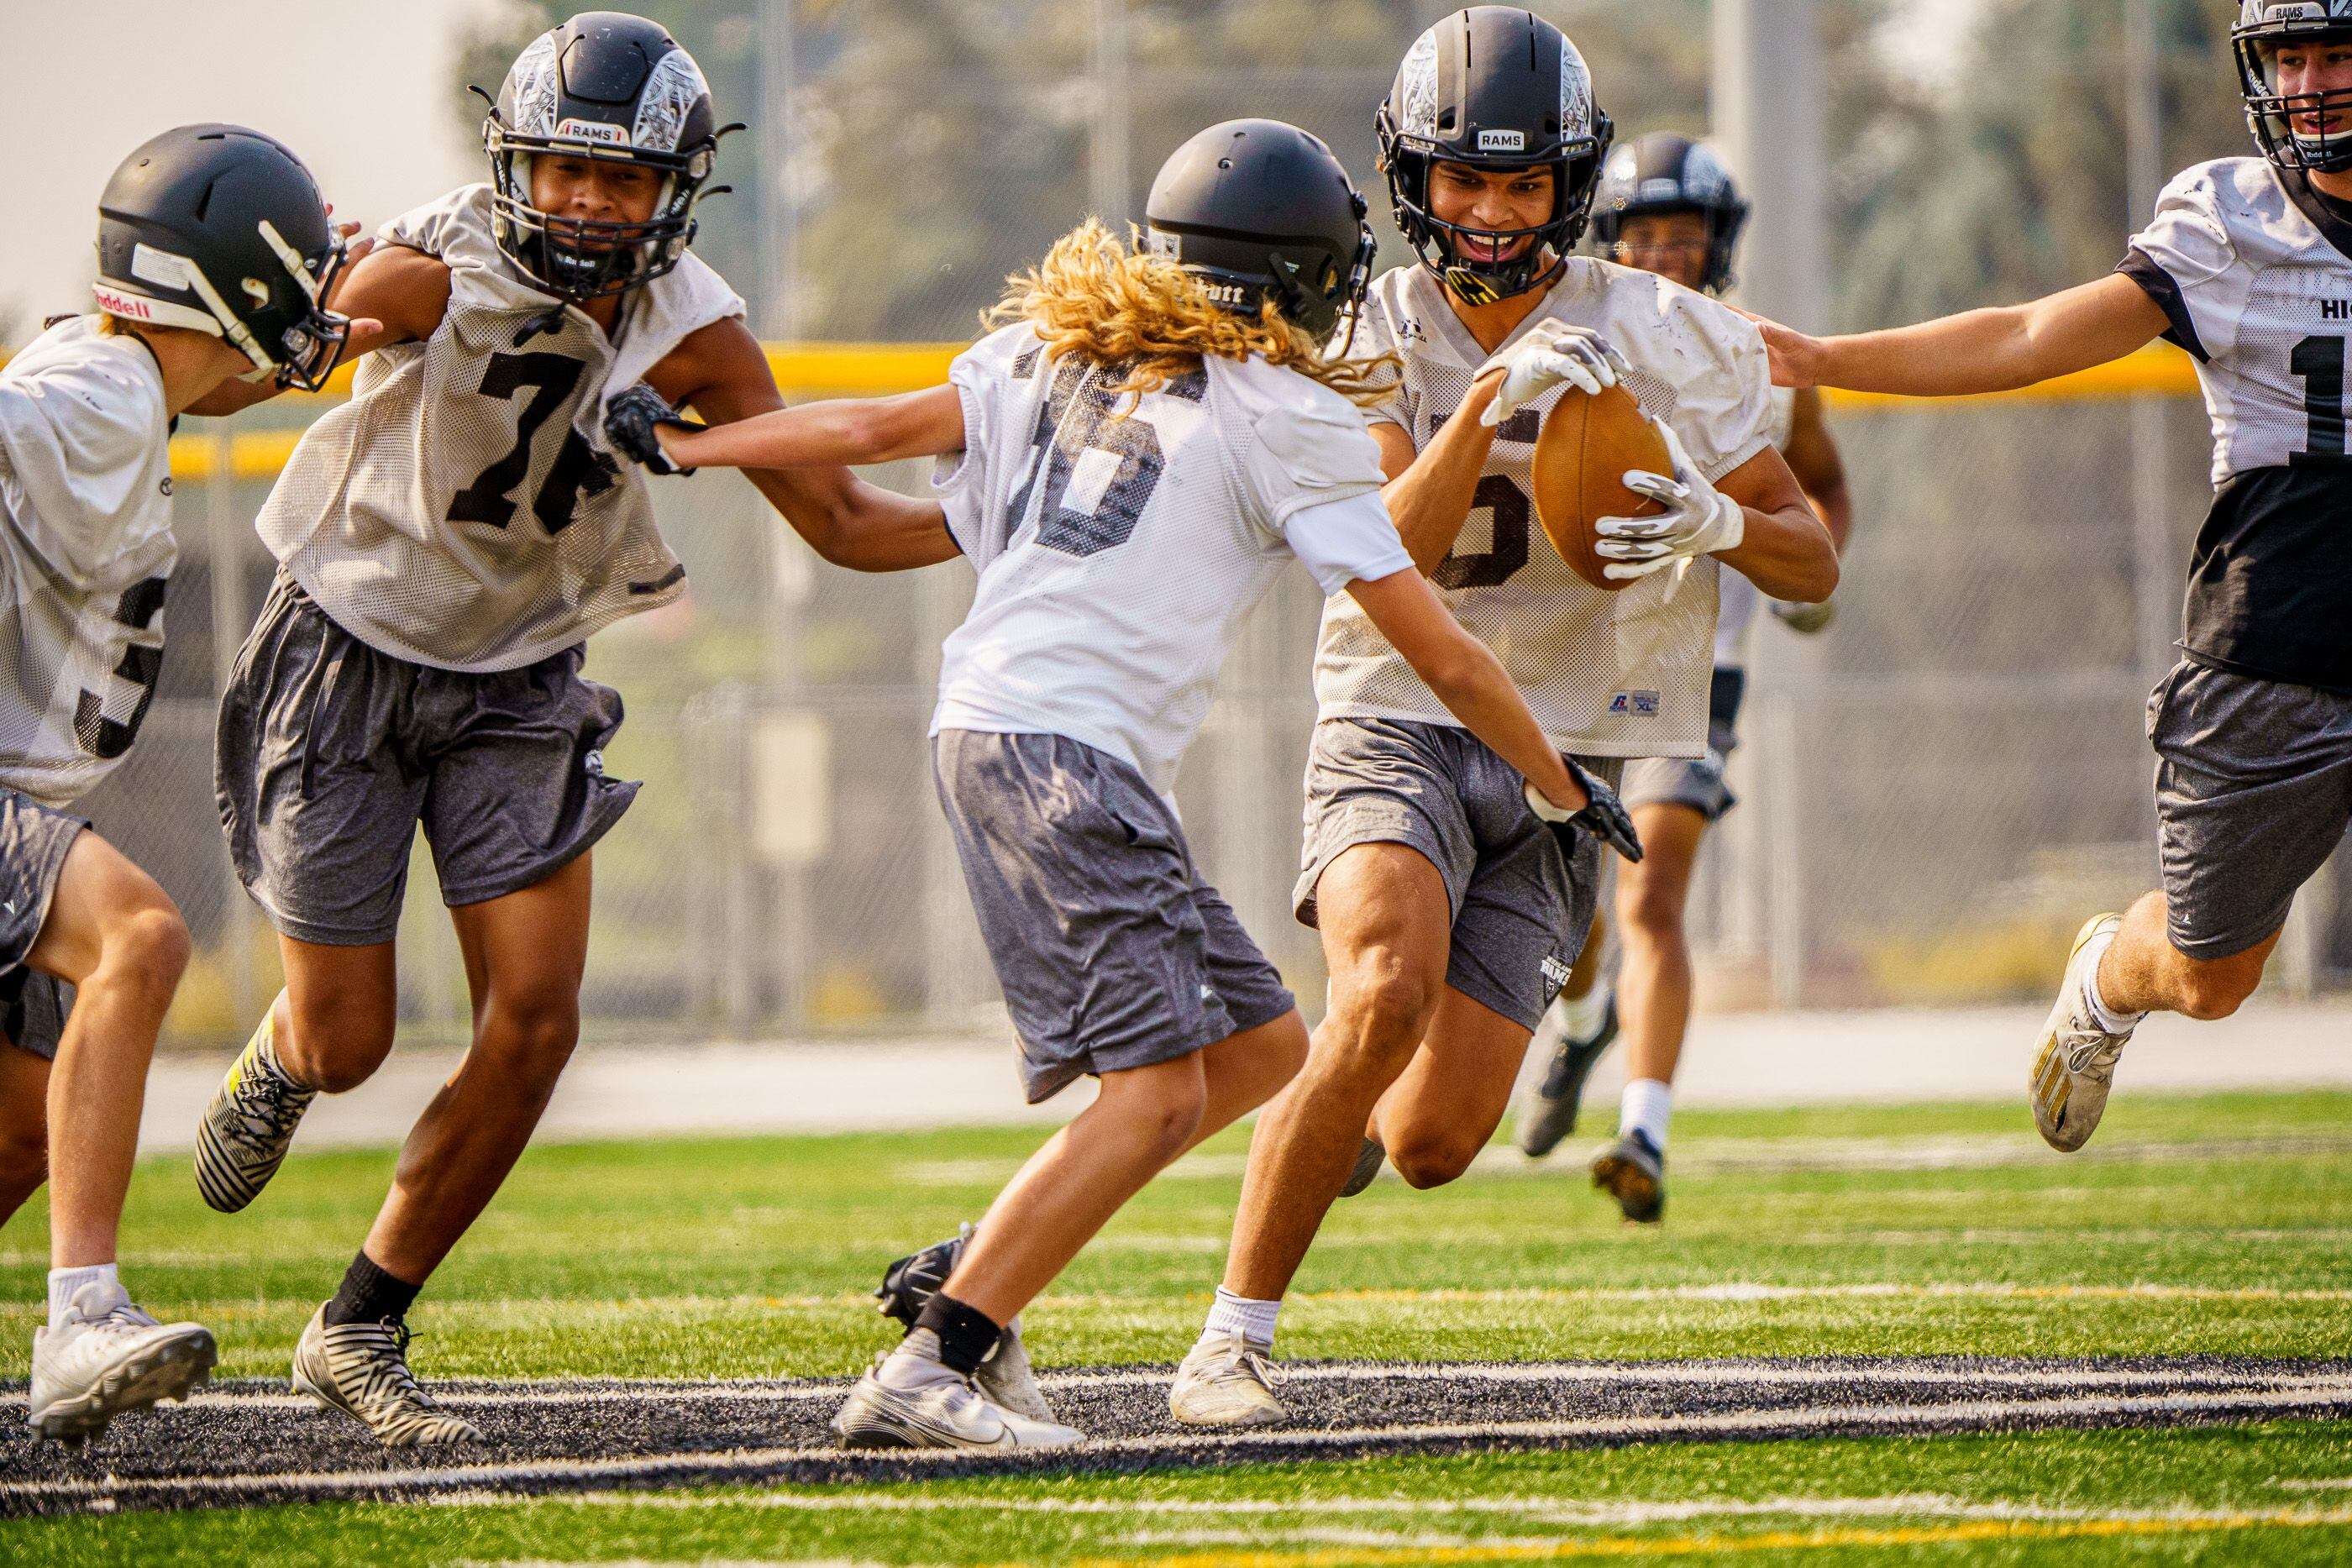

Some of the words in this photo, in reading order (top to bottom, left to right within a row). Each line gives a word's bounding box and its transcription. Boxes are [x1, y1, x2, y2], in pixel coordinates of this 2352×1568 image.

[2276, 7, 2303, 19] RAMS
[573, 125, 612, 140] RAMS
[1482, 135, 1520, 146] RAMS
[2321, 299, 2352, 319] HI
[1636, 703, 1653, 711] XL
